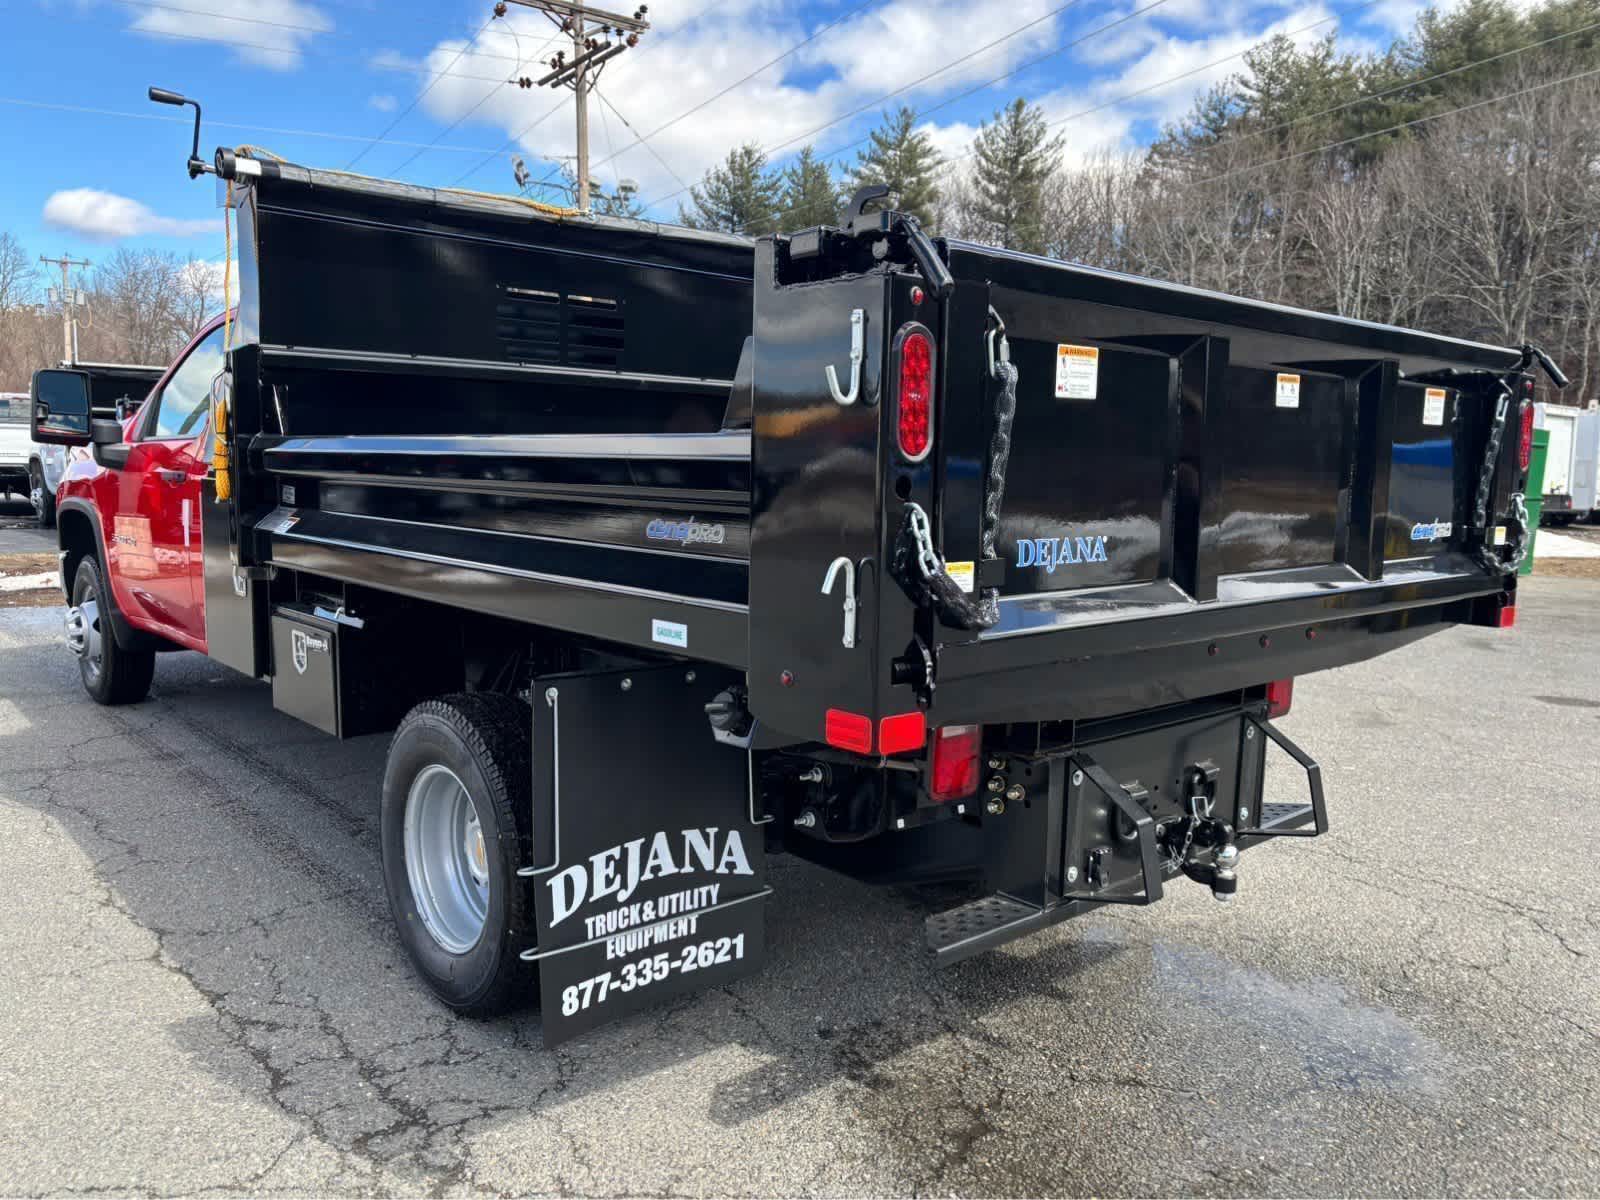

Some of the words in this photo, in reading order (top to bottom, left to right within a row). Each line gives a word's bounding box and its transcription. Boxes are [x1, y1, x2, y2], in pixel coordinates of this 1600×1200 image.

[1016, 536, 1107, 573] DEJANA
[546, 827, 754, 928] DEJANA
[606, 914, 699, 960] EQUIPMENT
[561, 933, 745, 1017] 877-335-2621
